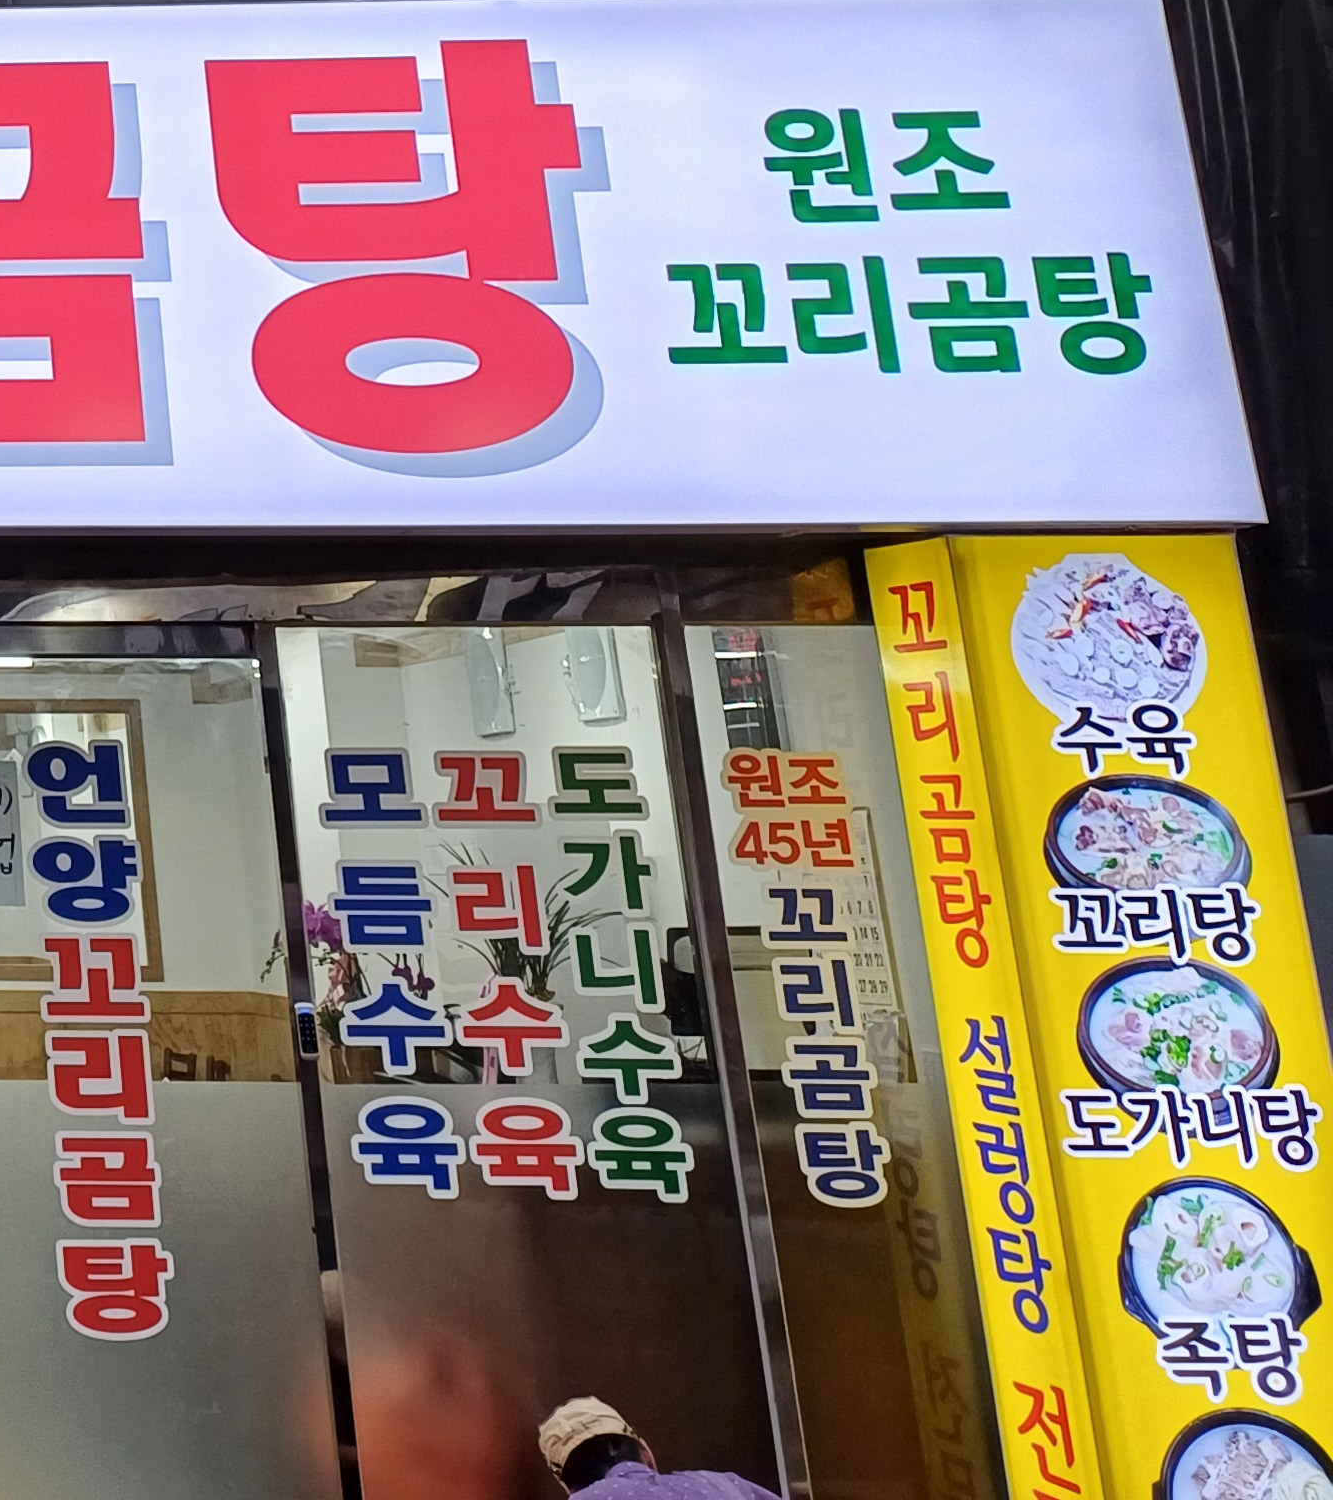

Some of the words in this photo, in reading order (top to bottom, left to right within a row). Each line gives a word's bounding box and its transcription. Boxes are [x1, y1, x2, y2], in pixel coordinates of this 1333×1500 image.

[763, 108, 1011, 223] 원조
[667, 252, 1153, 375] 꼬리곰탕
[726, 755, 840, 809] 원조
[1057, 704, 1193, 774] 수육
[734, 817, 855, 869] 45년
[323, 751, 460, 1192] 모듬수육
[436, 752, 578, 1193] 꼬리수육
[551, 750, 687, 1196] 도가니수육
[1054, 887, 1259, 963] 꼬리탕
[763, 887, 885, 1201] 꼬리곰탕
[887, 579, 993, 969] 꼬리곰탕
[959, 1014, 1053, 1335] 설렁탕
[1012, 1379, 1083, 1500] 전
[1062, 1088, 1318, 1167] 도가니탕
[1161, 1316, 1303, 1399] 족탕
